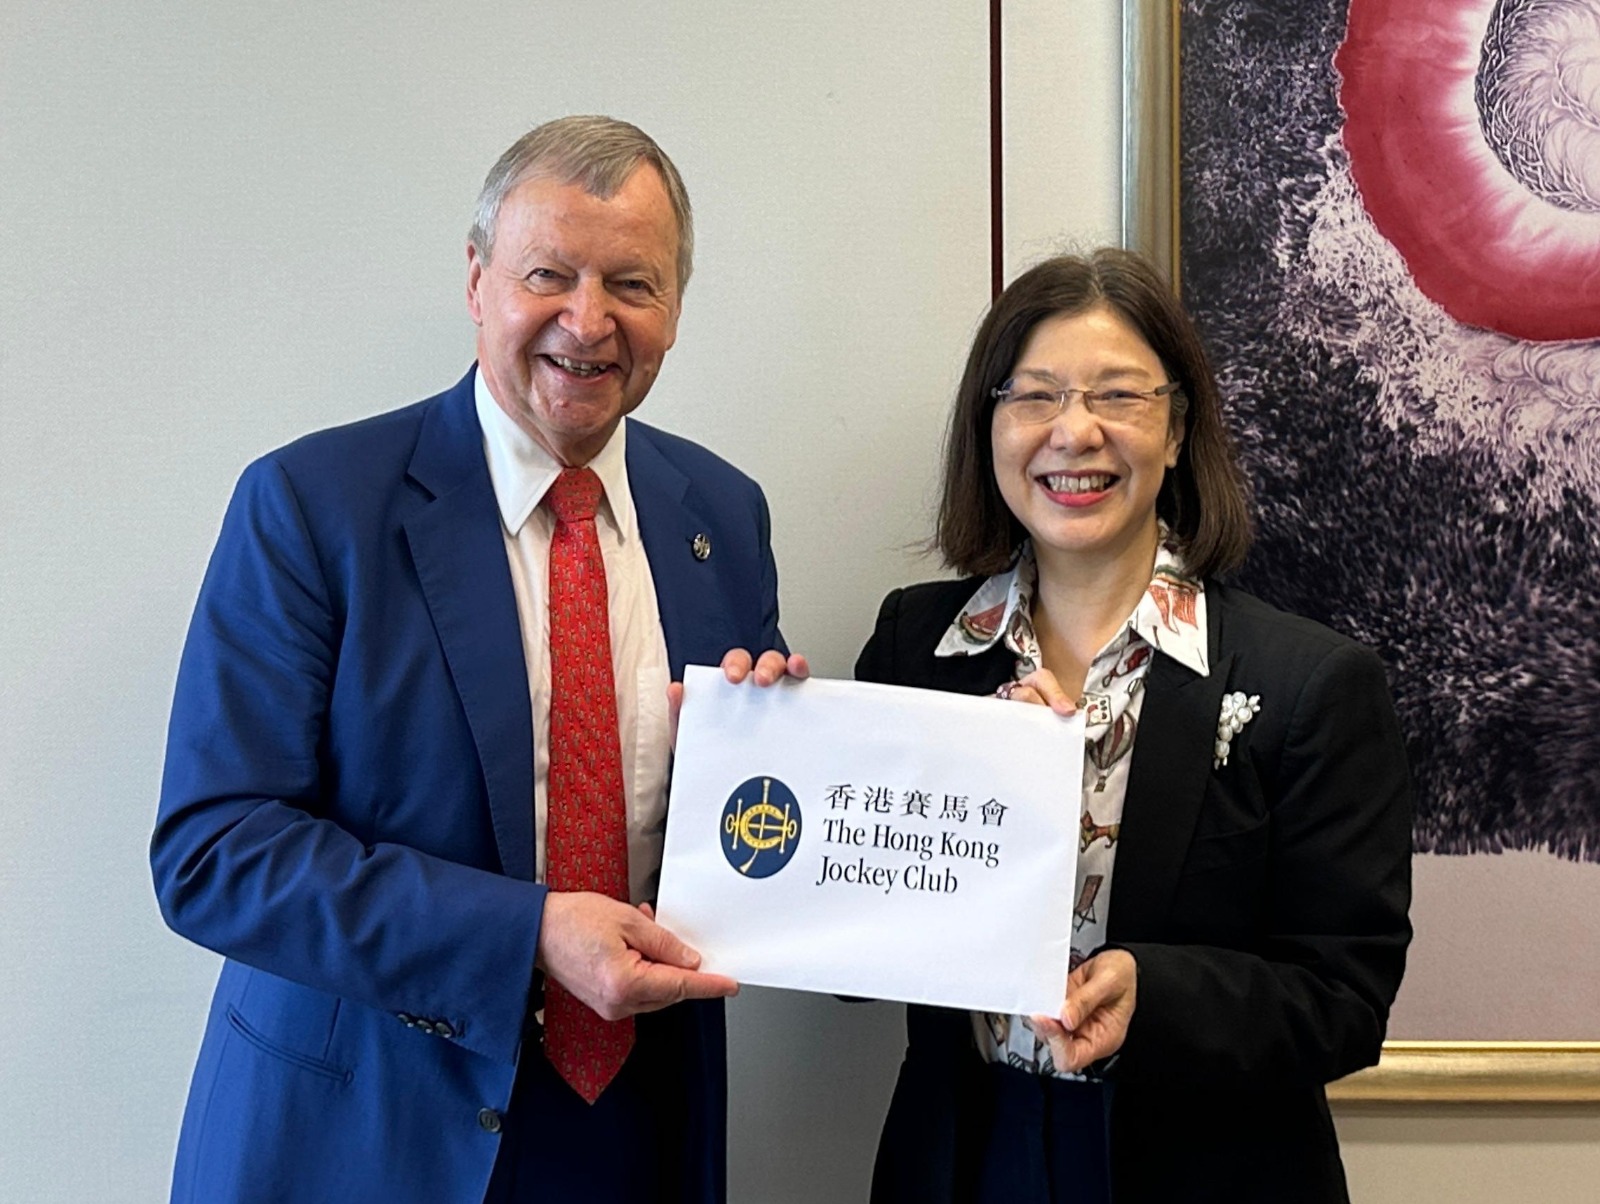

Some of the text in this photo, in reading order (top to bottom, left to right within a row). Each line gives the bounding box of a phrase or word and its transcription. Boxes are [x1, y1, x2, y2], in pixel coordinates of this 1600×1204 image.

[824, 783, 1009, 826] 香港賽馬會
[823, 818, 1000, 868] The Hong Kong
[815, 855, 958, 894] Jockey Club
